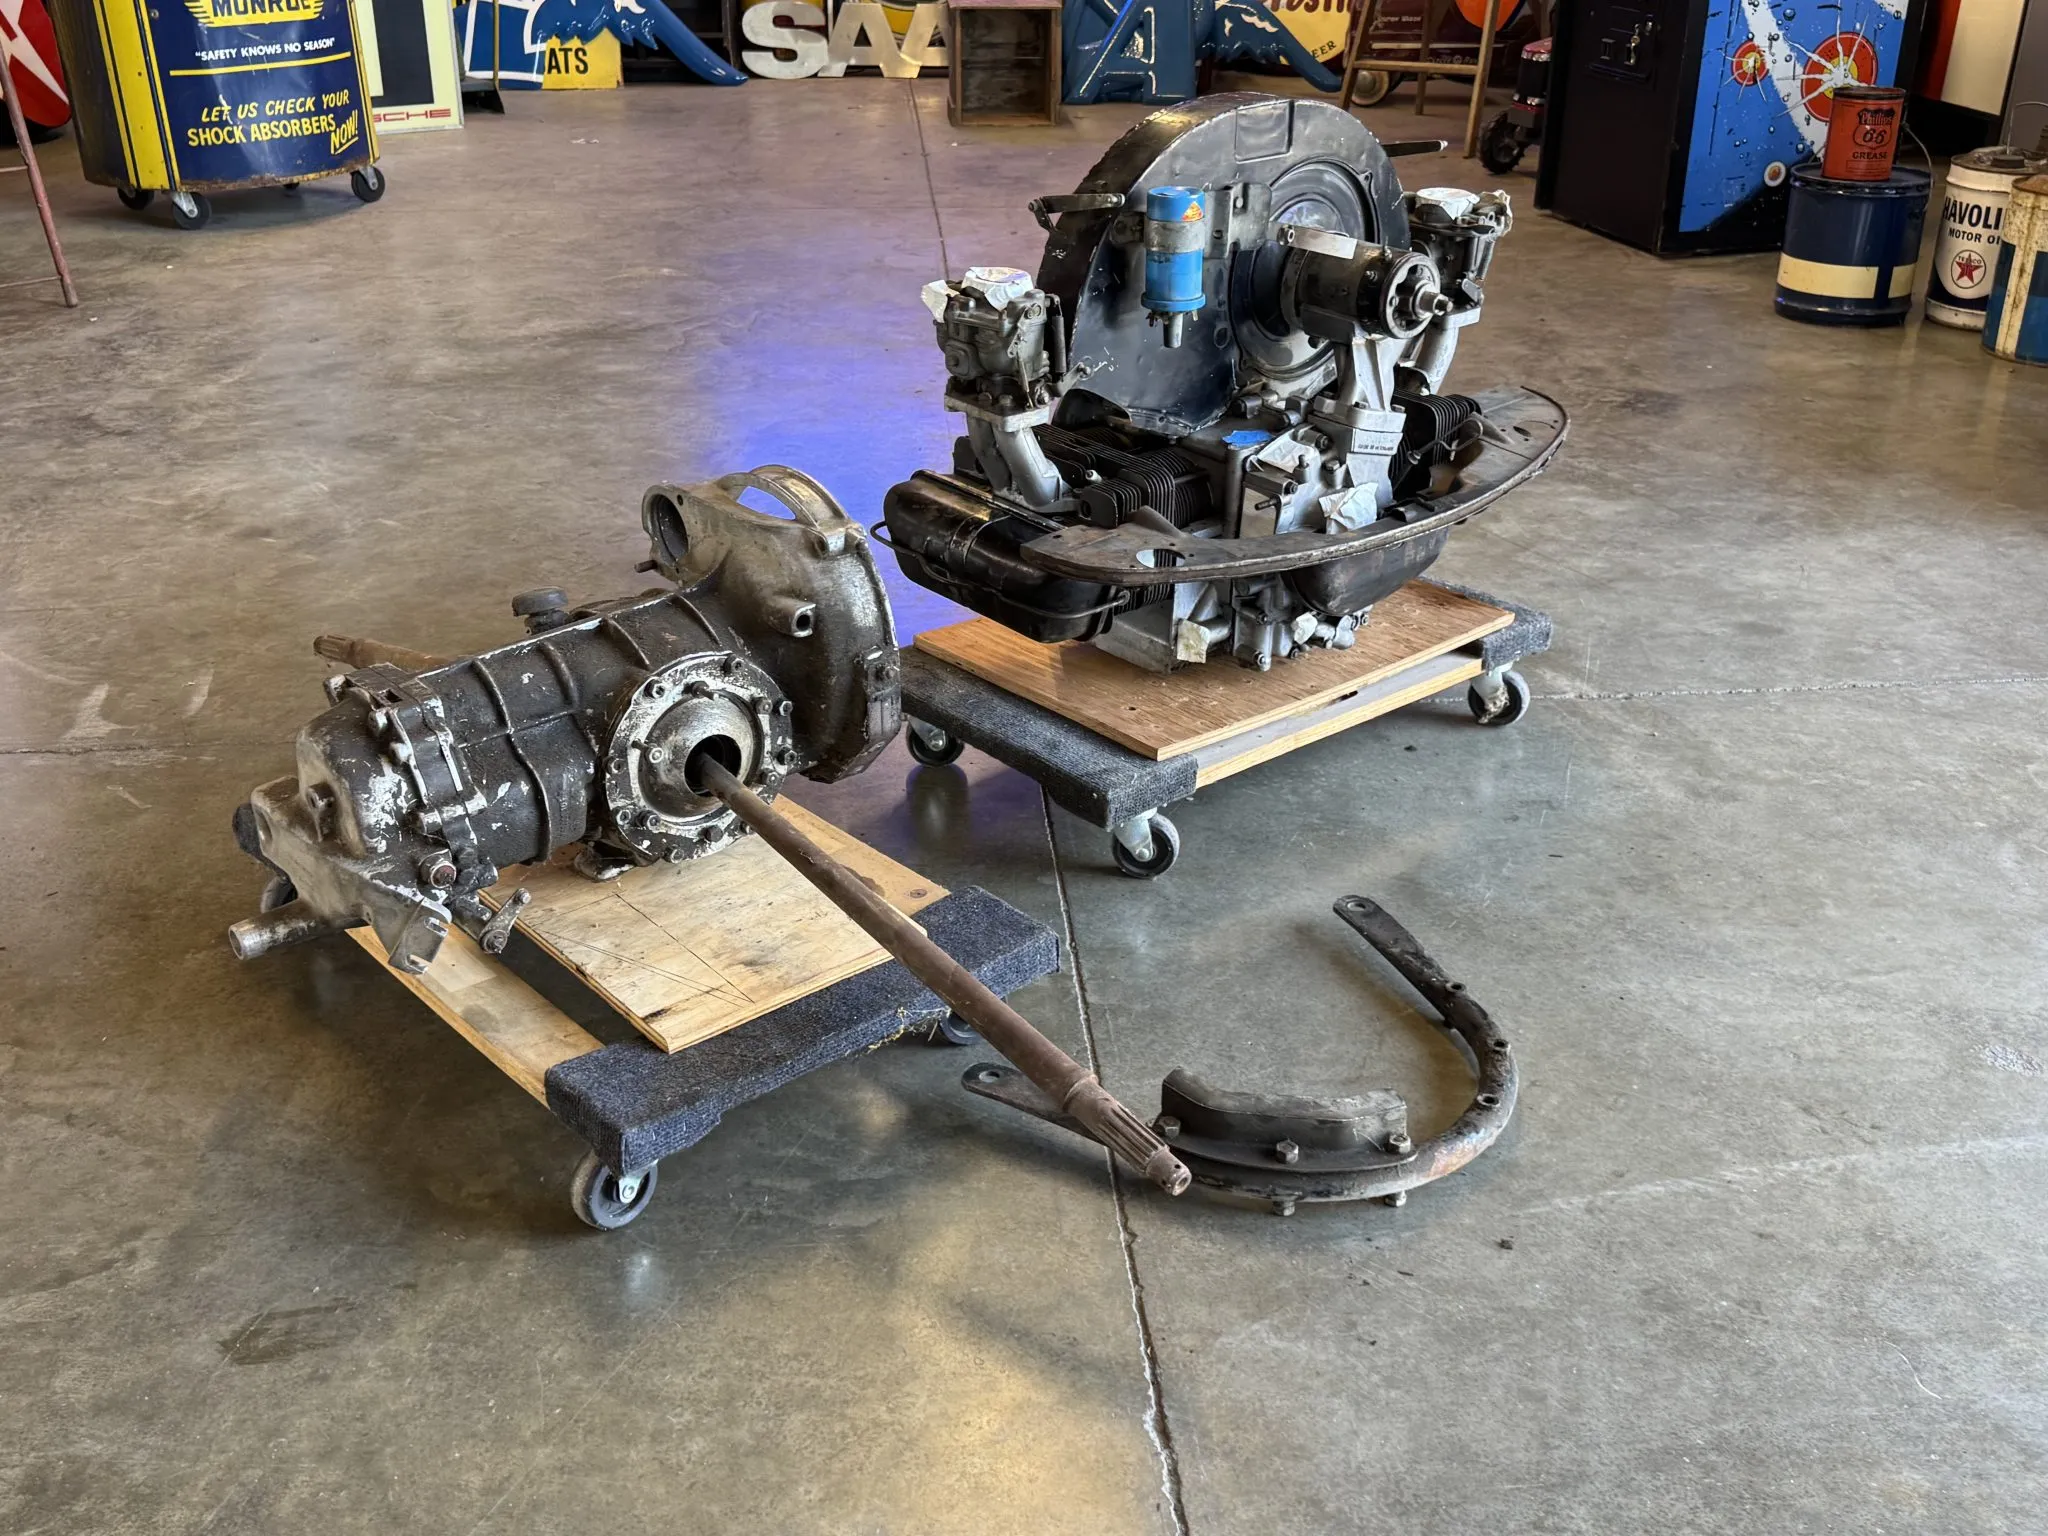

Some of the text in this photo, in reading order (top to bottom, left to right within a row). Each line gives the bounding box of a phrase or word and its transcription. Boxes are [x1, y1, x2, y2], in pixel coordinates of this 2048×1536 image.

[241, 43, 282, 58] KNOWS
[284, 42, 301, 54] NO
[201, 89, 349, 123] LET US CHECK YOUR
[187, 113, 336, 147] SHOCK ABSORBERS
[1863, 128, 1887, 144] 66
[1948, 227, 1982, 243] MOTOR
